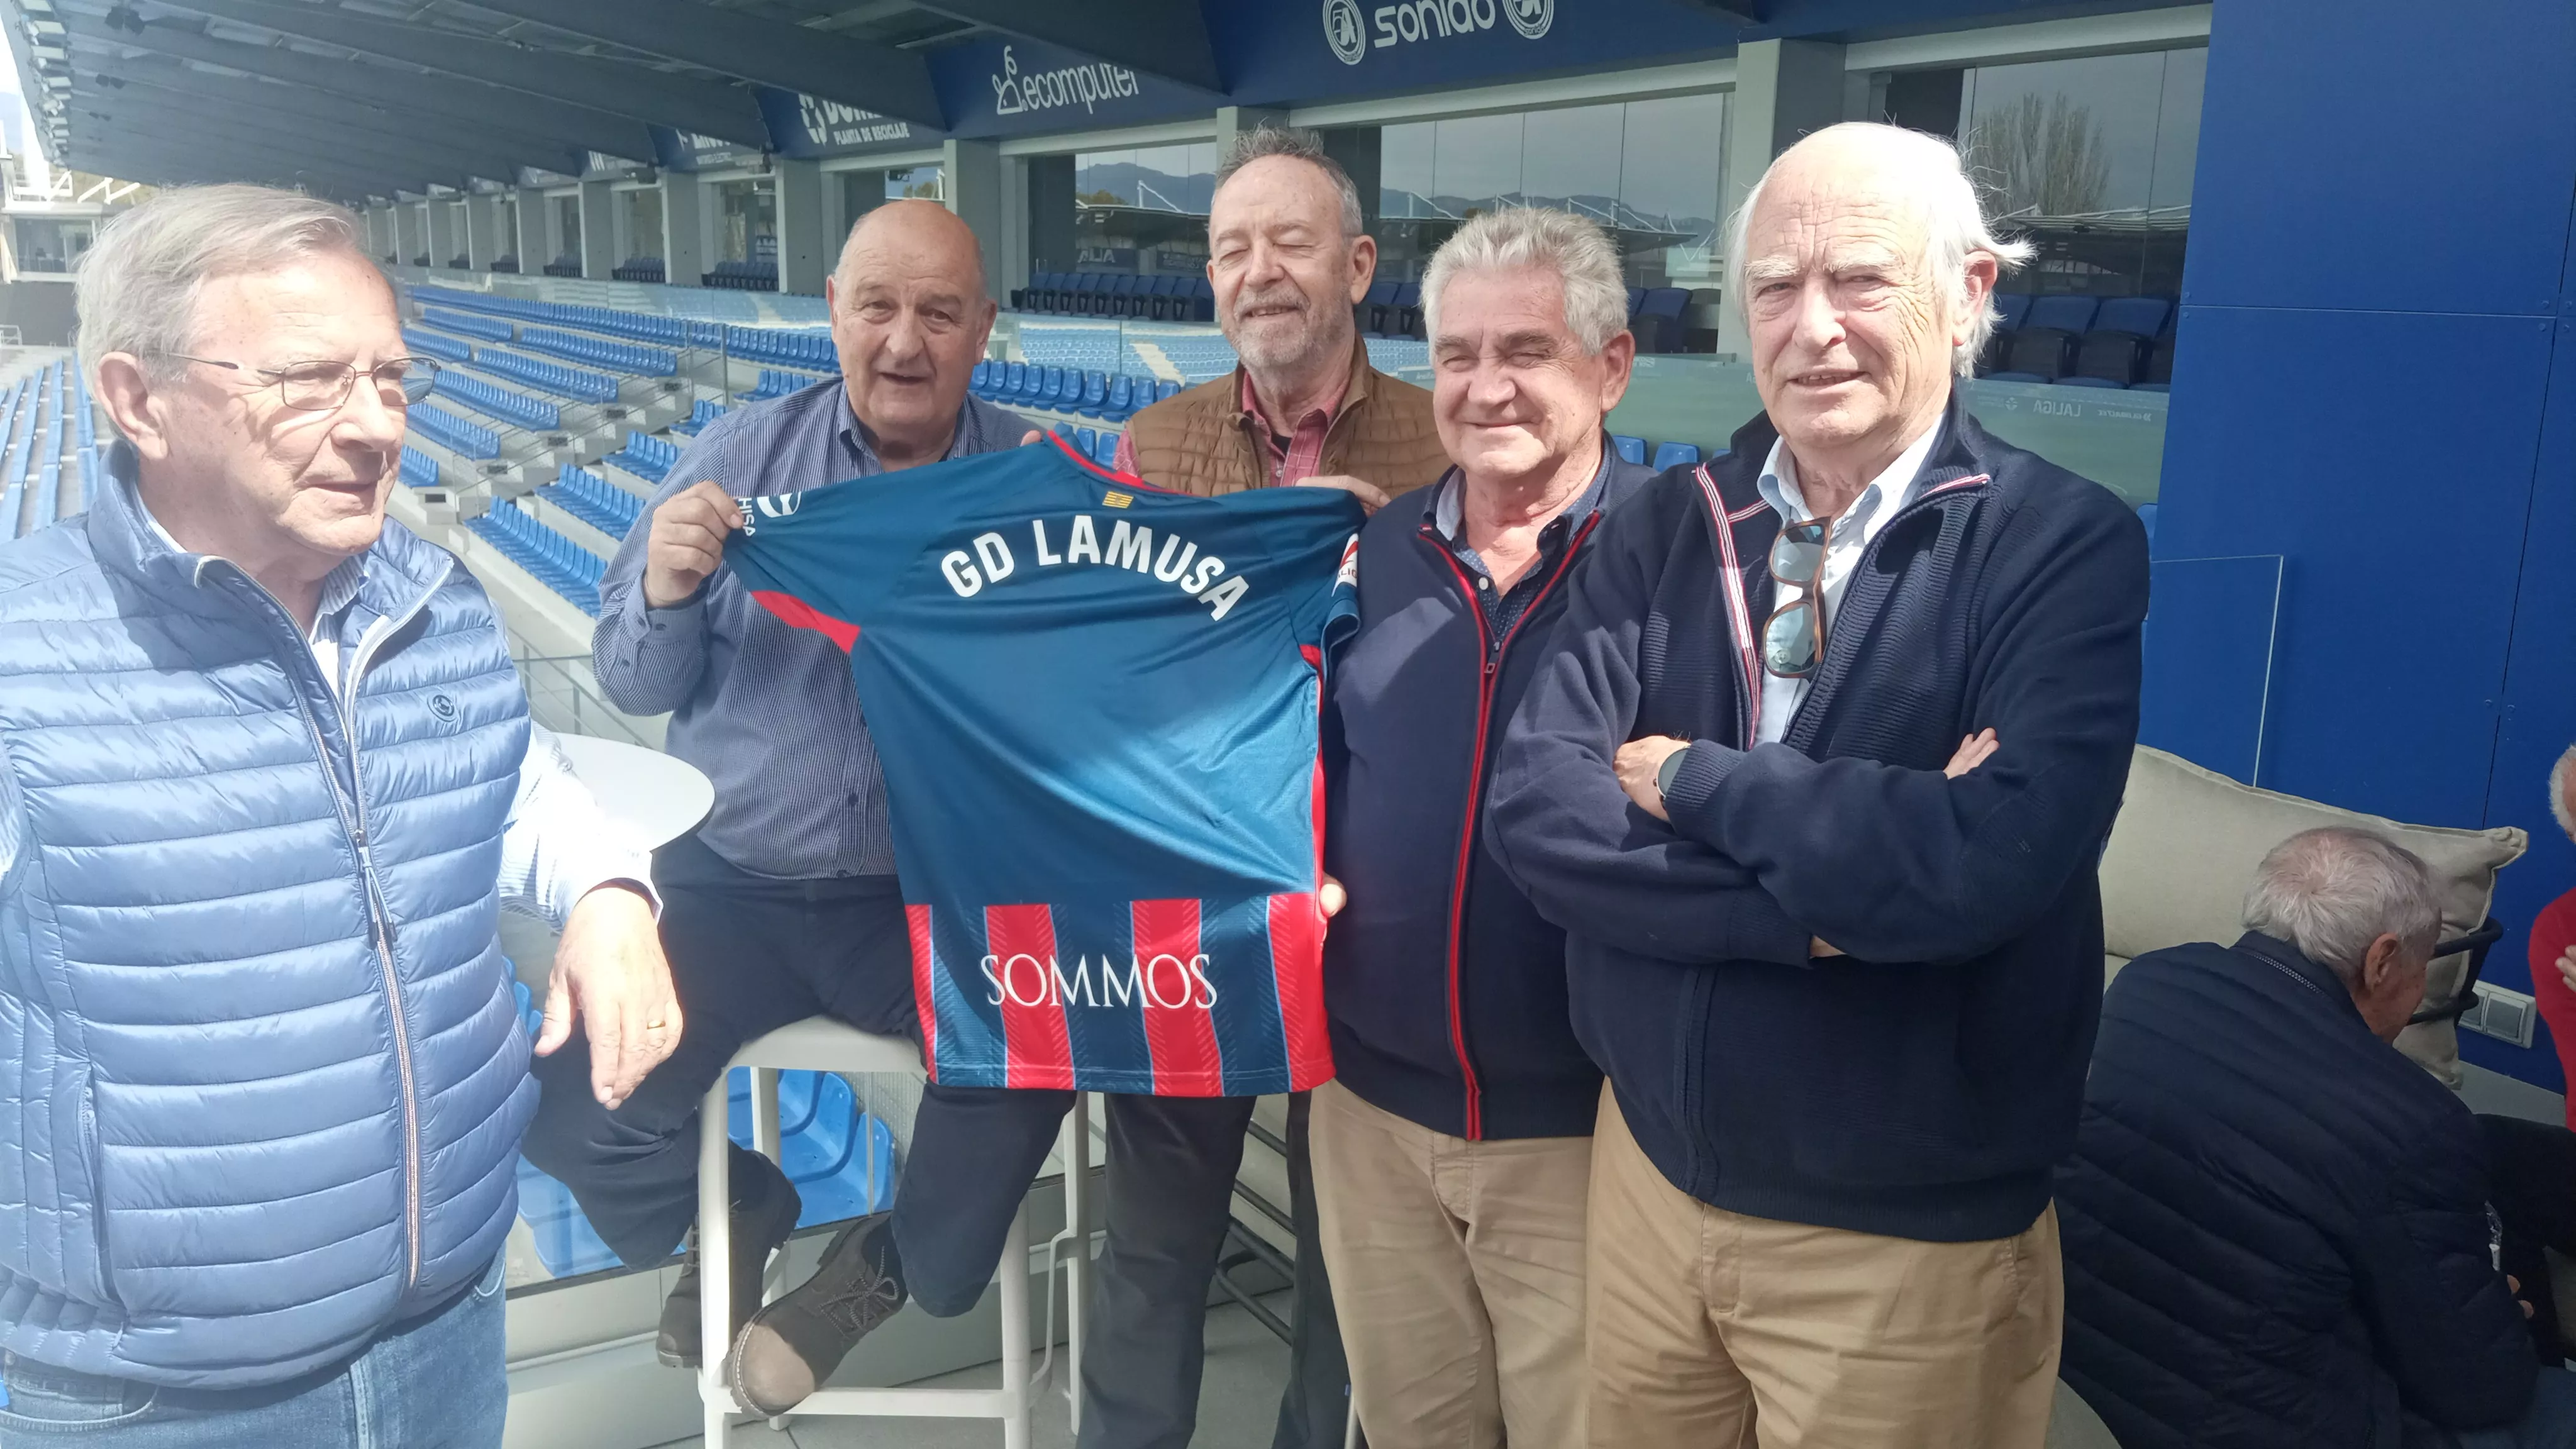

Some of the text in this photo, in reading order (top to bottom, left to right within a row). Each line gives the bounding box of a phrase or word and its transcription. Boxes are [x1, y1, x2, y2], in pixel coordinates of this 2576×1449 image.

[833, 121, 910, 145] PLANTA DE RECICLAJE
[940, 514, 1250, 622] GD LAMUSA
[980, 953, 1218, 1009] SOMMOS
